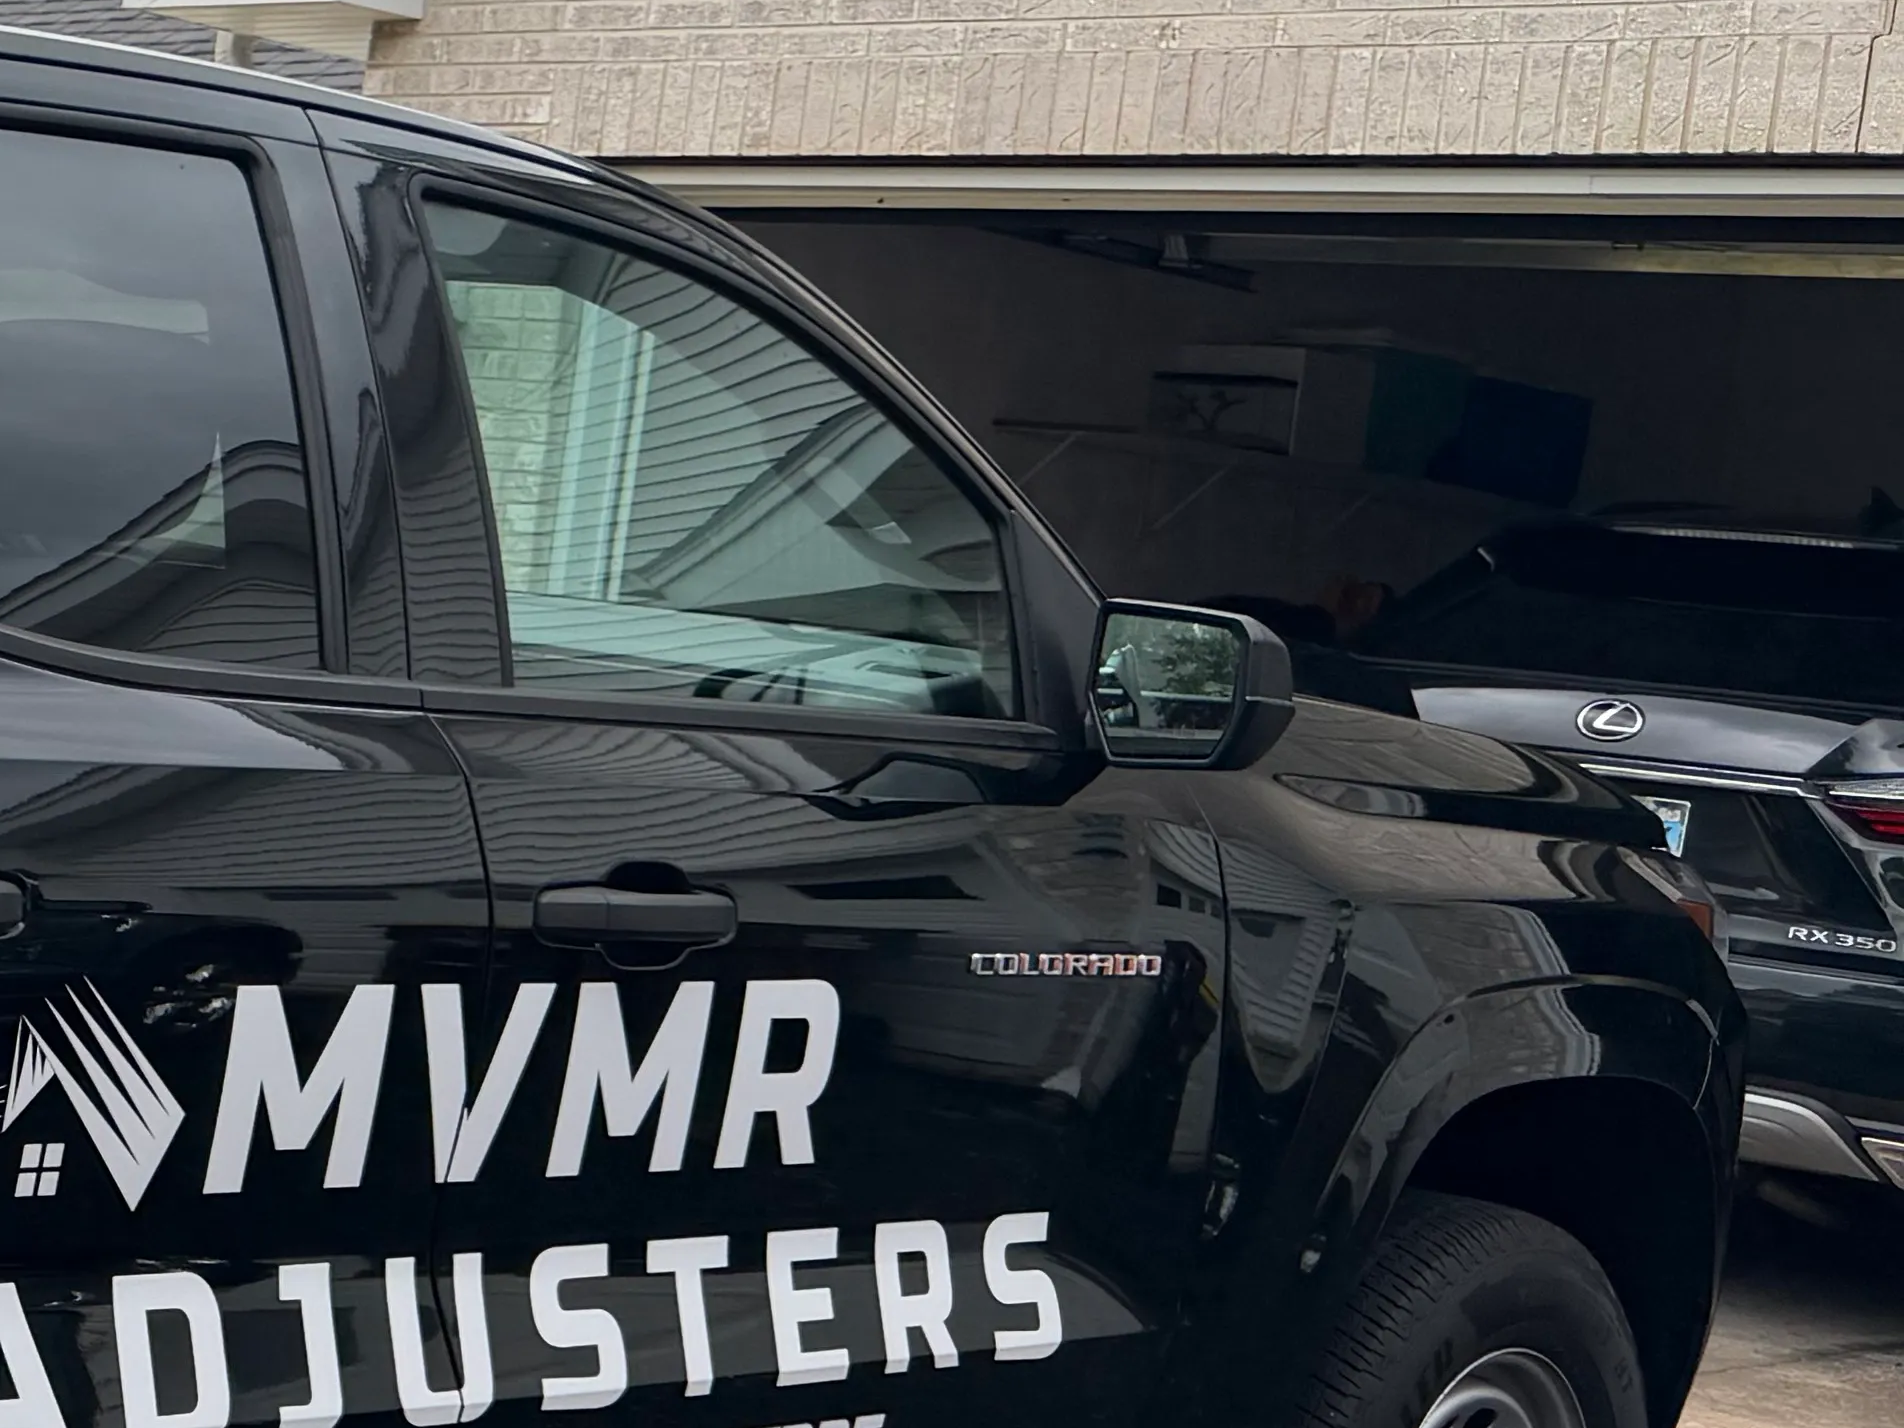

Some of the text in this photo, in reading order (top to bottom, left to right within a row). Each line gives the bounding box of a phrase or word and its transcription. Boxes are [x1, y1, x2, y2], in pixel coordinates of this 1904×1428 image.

[1788, 926, 1897, 953] RX 350
[967, 952, 1161, 977] COLORADO
[202, 978, 840, 1196] MVMR
